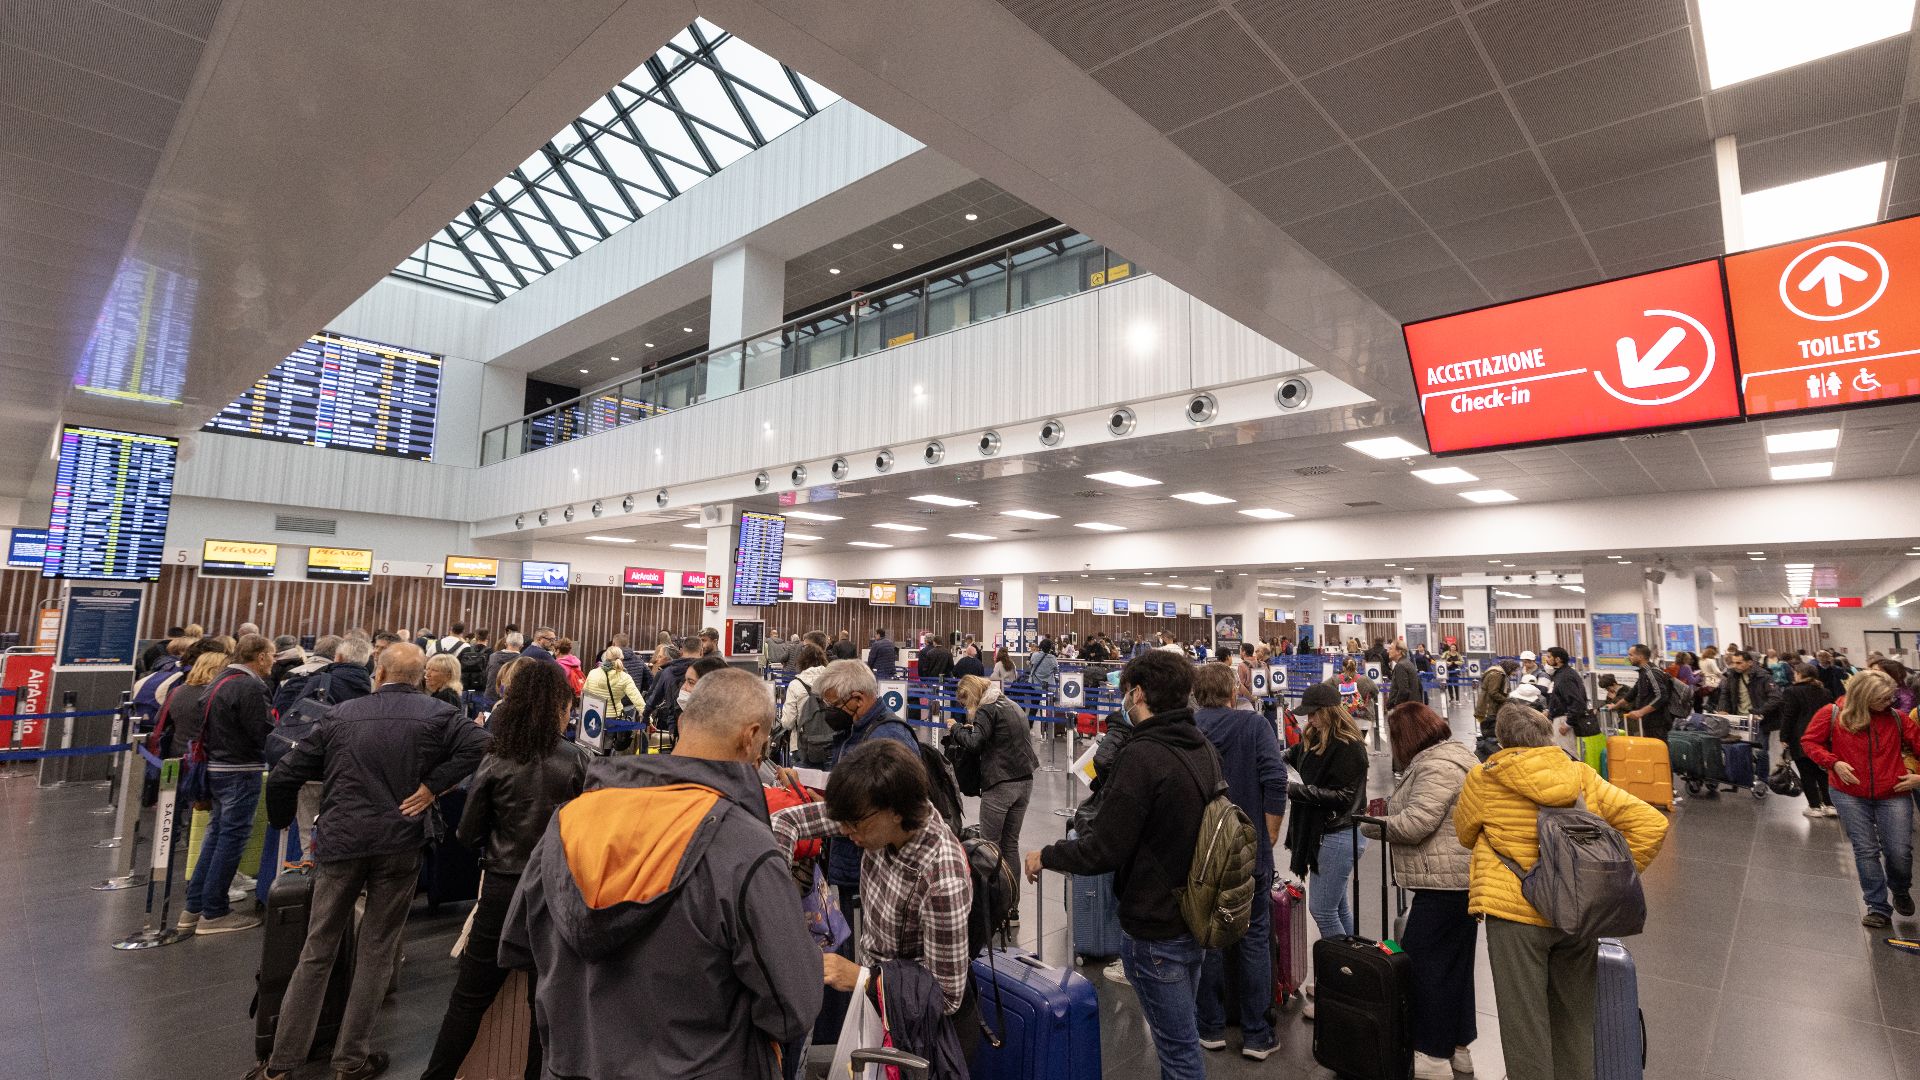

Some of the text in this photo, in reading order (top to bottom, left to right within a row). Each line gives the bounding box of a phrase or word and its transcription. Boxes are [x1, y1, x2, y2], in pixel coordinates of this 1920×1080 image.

[1798, 330, 1881, 360] TOILETS
[1426, 347, 1545, 386] ACCETTAZIONE
[1450, 386, 1531, 415] Check-in
[177, 550, 187, 562] 5
[213, 545, 268, 556] PEGASUS
[316, 548, 365, 557] PEGASUS
[381, 562, 390, 574] 6
[426, 565, 433, 575] 7
[575, 573, 582, 583] 8
[608, 575, 614, 584] 9
[631, 571, 659, 582] AirArabia
[1068, 685, 1075, 694] 7
[22, 668, 45, 734] AirAraia
[888, 696, 897, 707] 6
[588, 717, 596, 730] 4
